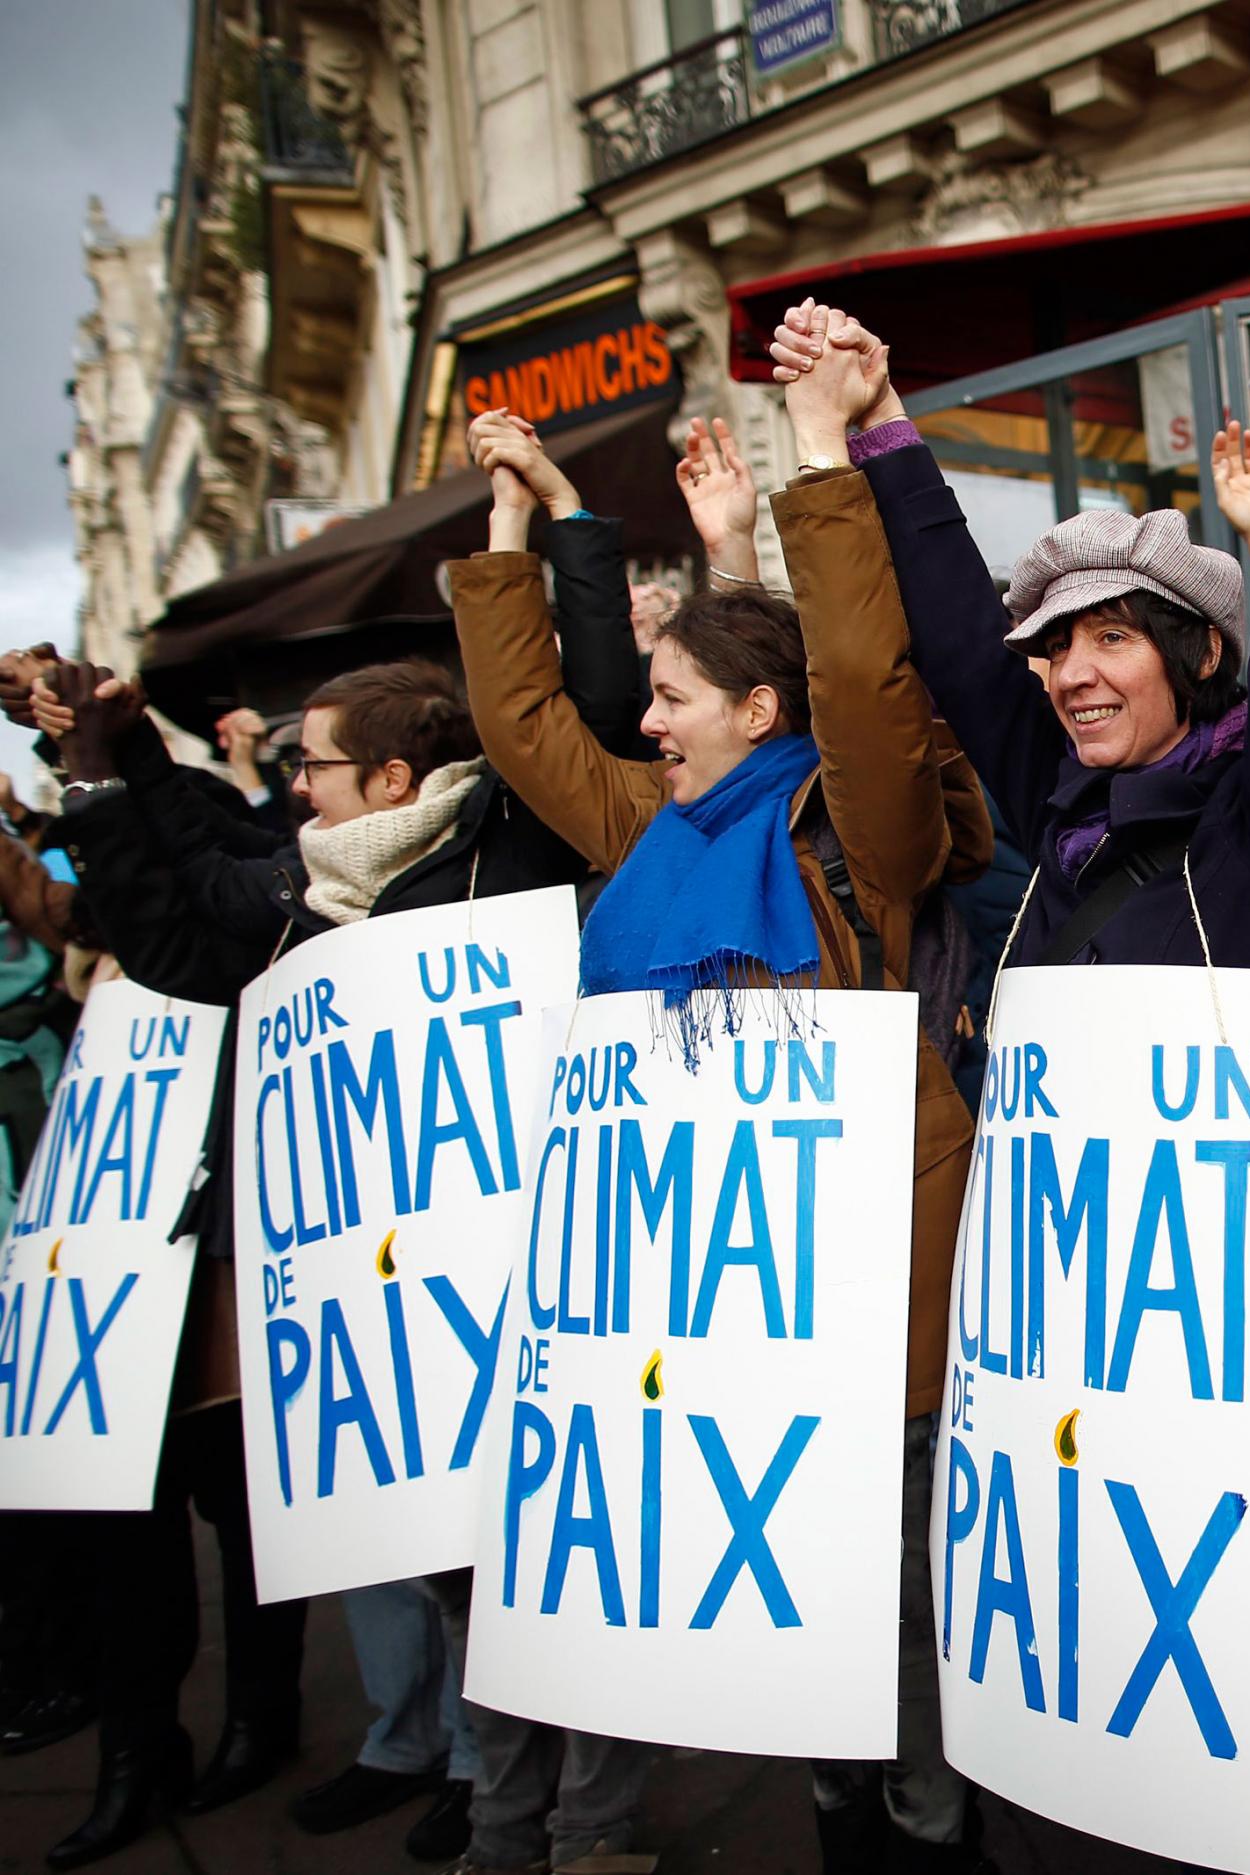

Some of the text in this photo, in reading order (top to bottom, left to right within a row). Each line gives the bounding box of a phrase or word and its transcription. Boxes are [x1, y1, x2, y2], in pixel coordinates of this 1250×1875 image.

[466, 320, 671, 426] SANDWICHS
[129, 1015, 191, 1061] UN
[257, 943, 511, 1072] POUR UN
[254, 1000, 523, 1254] CLIMAT
[549, 1039, 837, 1119] POUR UN
[984, 1042, 1060, 1123] OUR
[527, 1119, 843, 1340] CLIMAT
[262, 1257, 297, 1317] DE
[0, 1272, 140, 1438] AIX
[517, 1338, 549, 1393] DE
[952, 1362, 974, 1432] DE
[502, 1401, 822, 1630] PAIX
[943, 1435, 1249, 1761] PAIX
